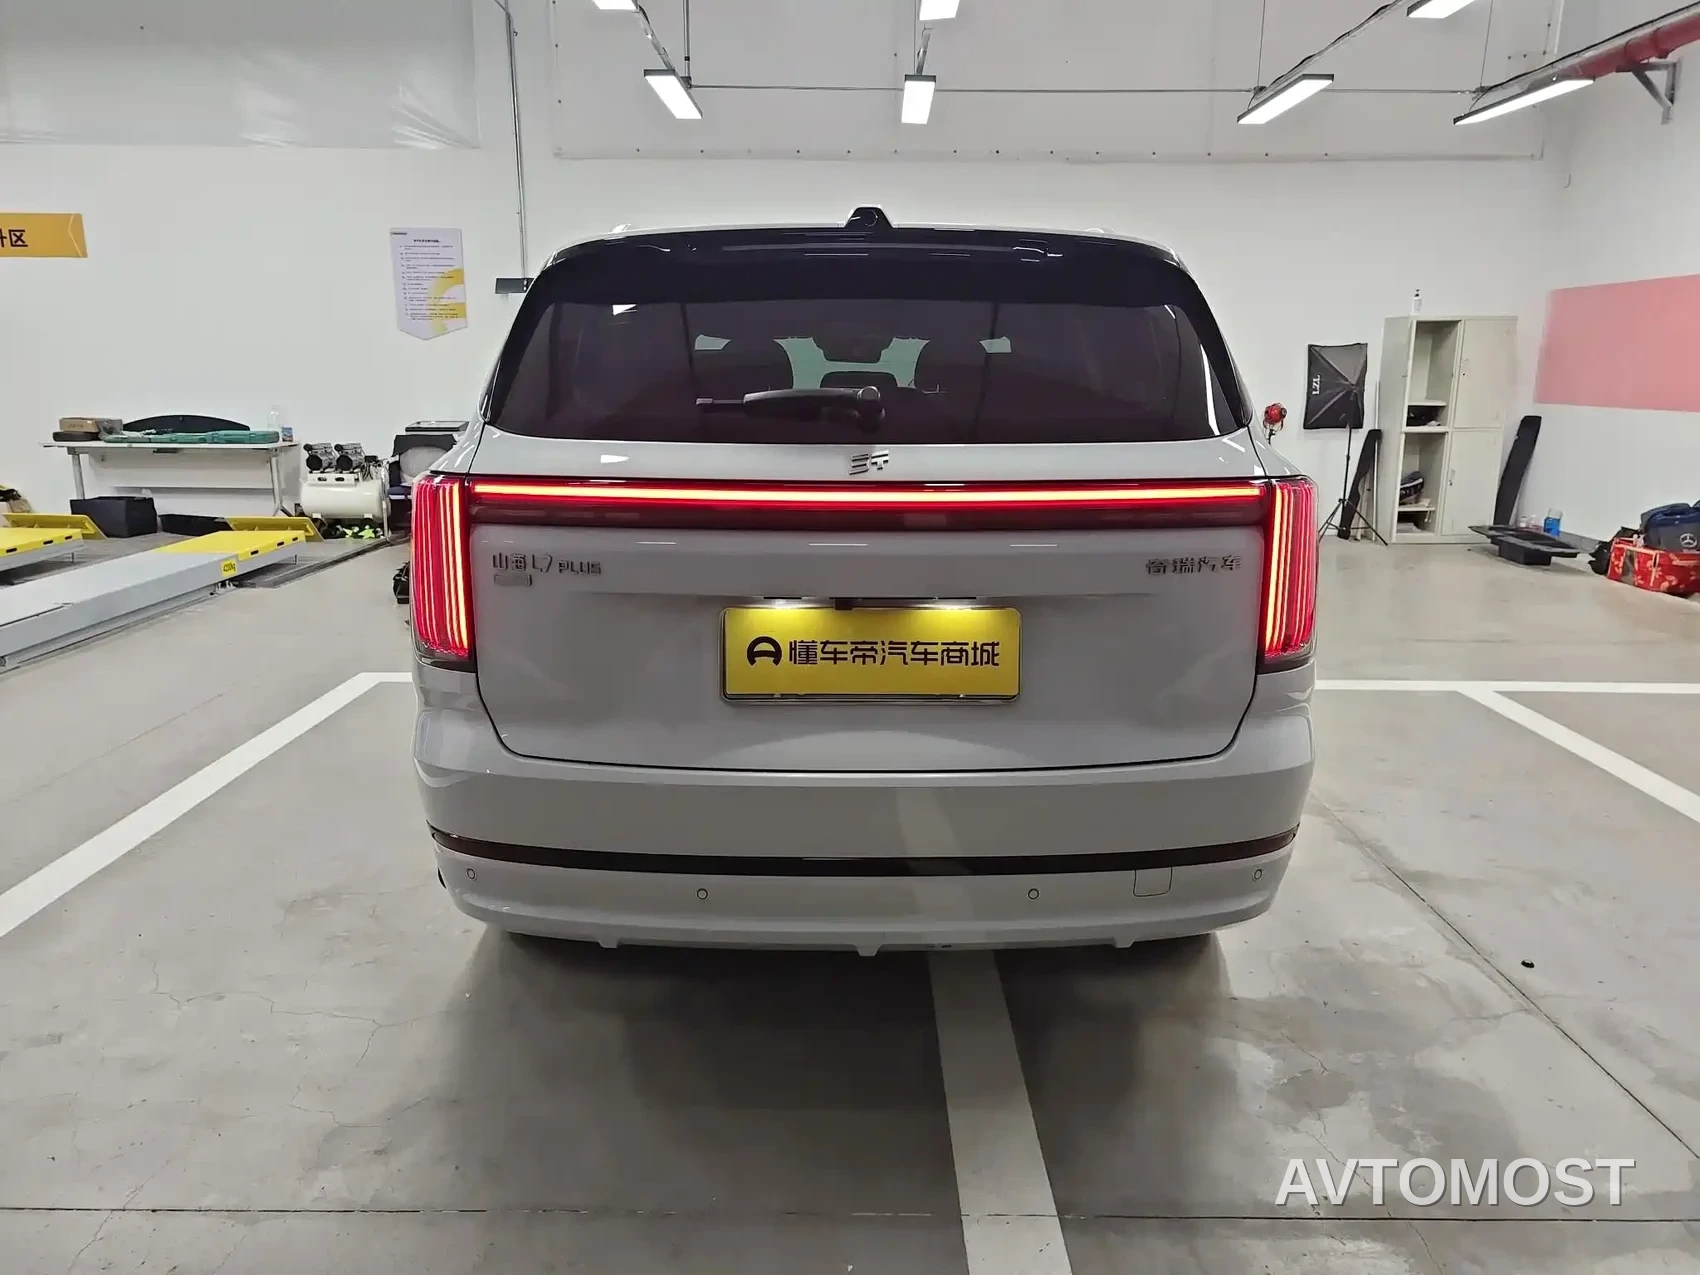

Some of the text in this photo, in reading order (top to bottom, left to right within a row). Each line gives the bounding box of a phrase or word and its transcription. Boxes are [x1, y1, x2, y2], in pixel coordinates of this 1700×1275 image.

[788, 640, 1001, 667] 懂车帝汽车商城
